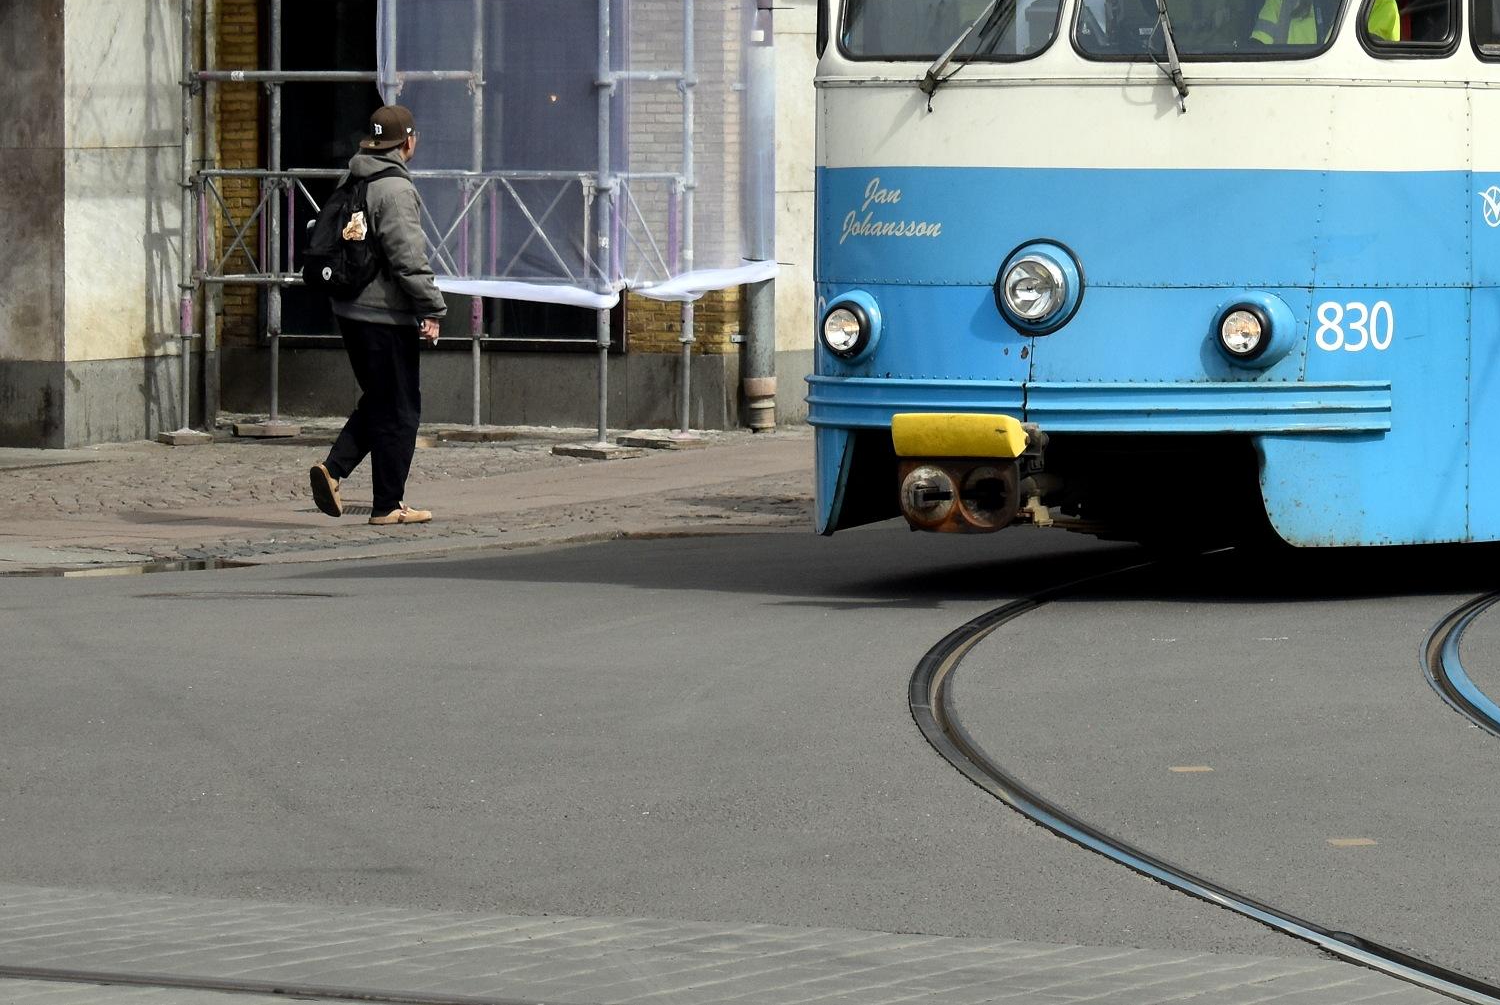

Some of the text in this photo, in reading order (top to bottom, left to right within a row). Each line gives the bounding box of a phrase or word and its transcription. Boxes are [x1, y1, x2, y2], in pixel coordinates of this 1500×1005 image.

[861, 177, 902, 212] Jan
[840, 210, 942, 245] Johansson
[1315, 300, 1394, 352] 830
